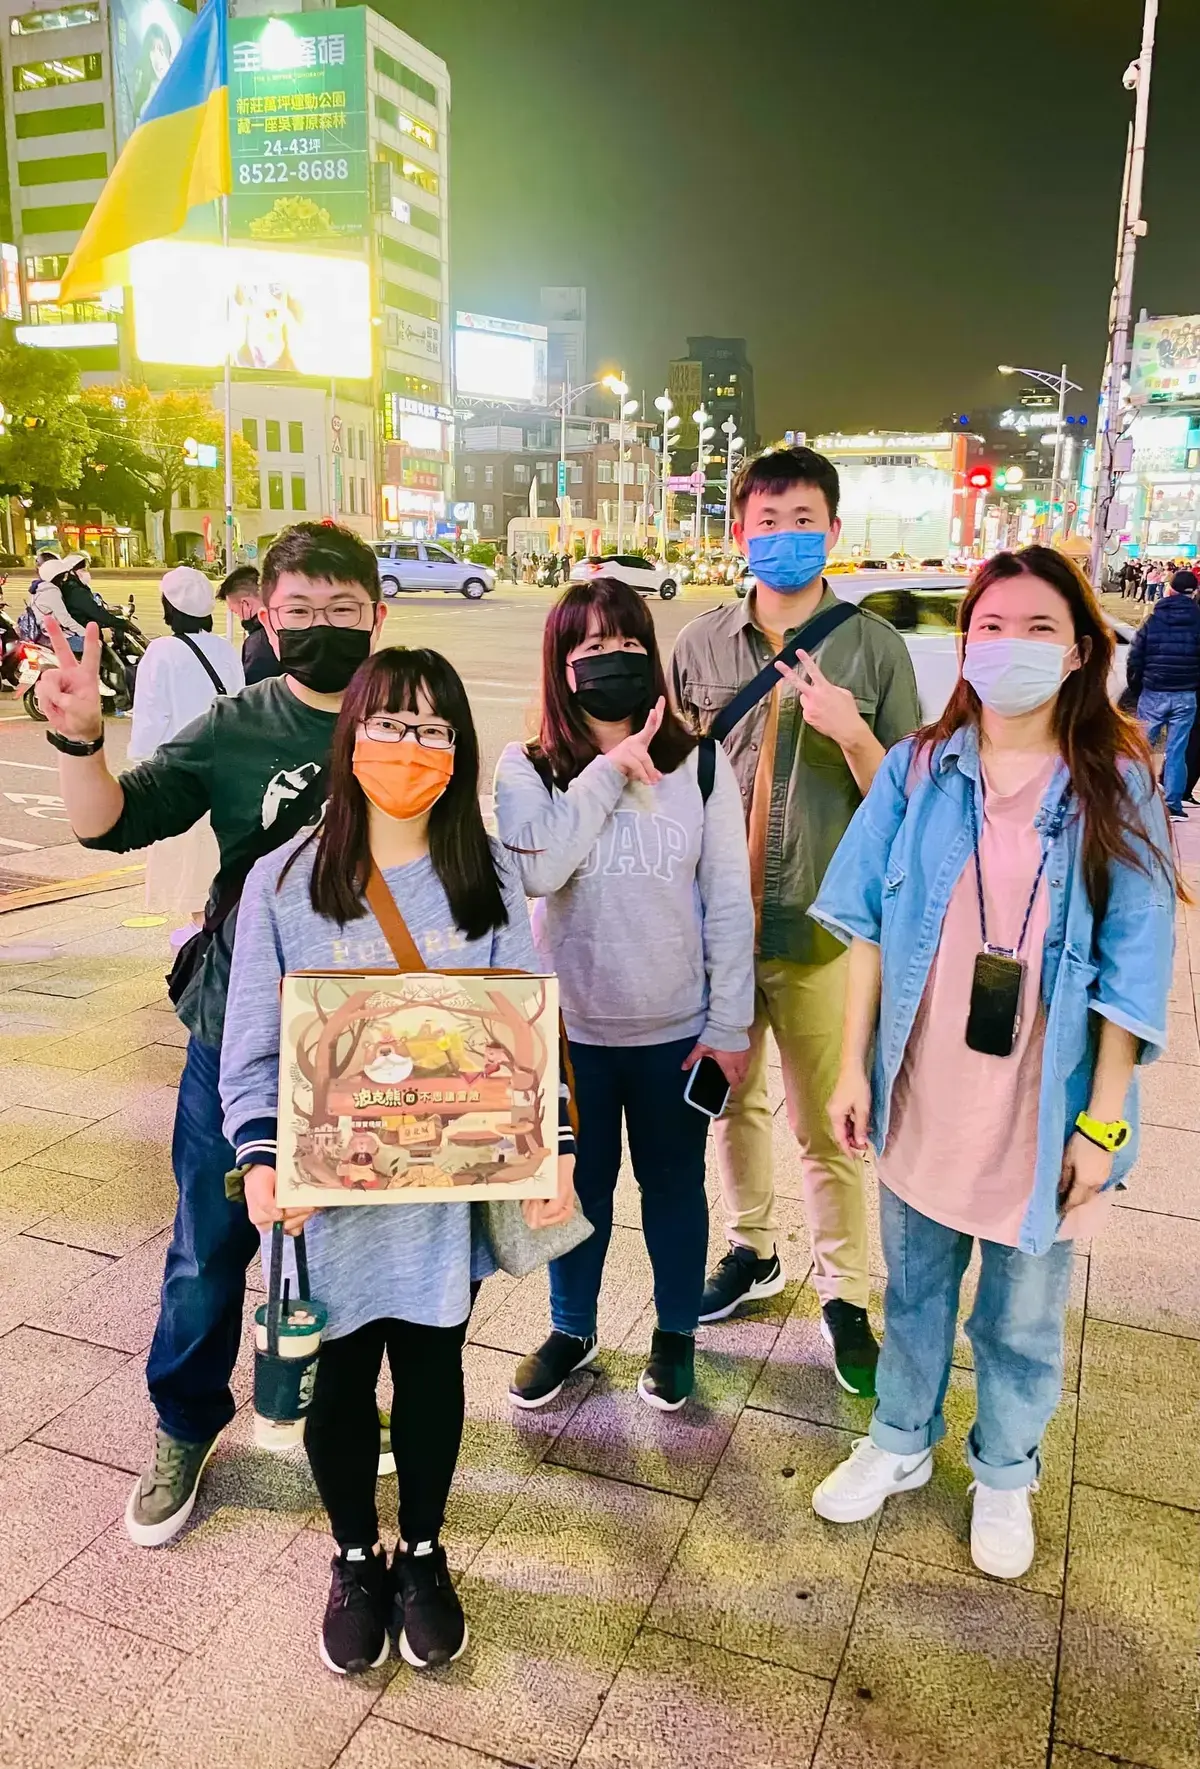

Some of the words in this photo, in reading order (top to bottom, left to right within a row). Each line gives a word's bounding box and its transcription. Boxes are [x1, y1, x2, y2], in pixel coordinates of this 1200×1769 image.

[236, 91, 346, 115] 新莊萬坪運動公園
[264, 138, 320, 156] 24-43坪
[239, 159, 348, 184] 8522-8688
